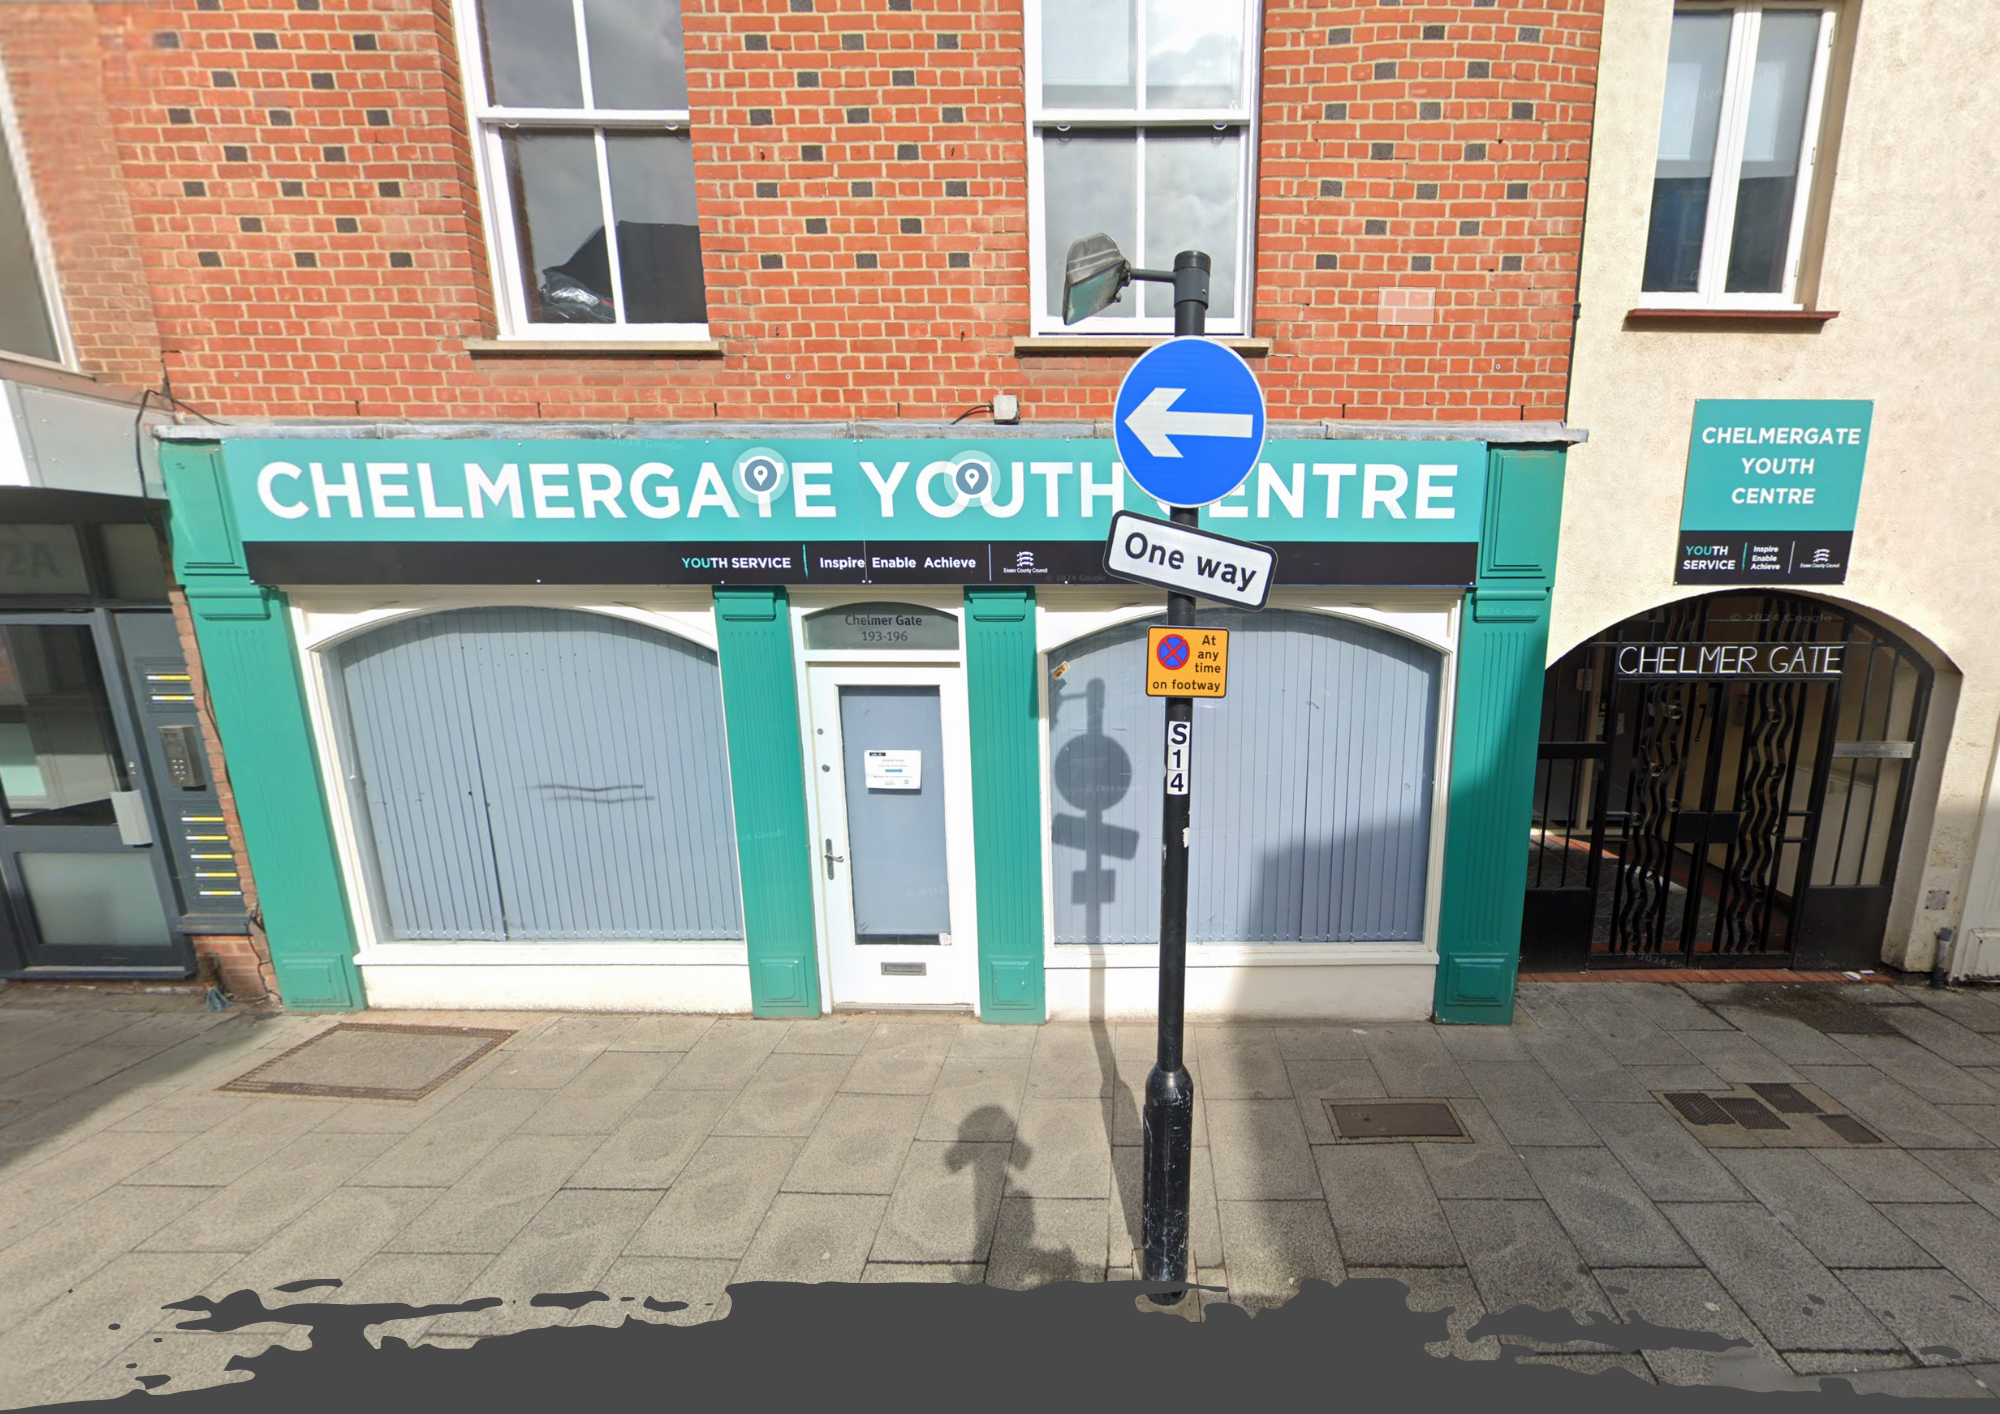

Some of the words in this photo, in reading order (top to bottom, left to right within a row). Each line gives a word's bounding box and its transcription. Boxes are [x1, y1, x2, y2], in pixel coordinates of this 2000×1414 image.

[1701, 426, 1862, 445] CHELMERGATE
[1741, 457, 1815, 475] YOUTH
[859, 460, 1124, 519] YOUTH
[1157, 461, 1458, 520] NTRE
[1731, 487, 1816, 505] CENTRE
[1686, 545, 1729, 556] YOUTH
[1753, 545, 1779, 554] Inspire
[682, 557, 728, 569] YOUTH
[732, 557, 792, 569] SERVICE
[819, 557, 866, 570] Inspire
[872, 557, 917, 568] Enable
[924, 557, 977, 568] Achieve
[1124, 531, 1185, 571] One
[1196, 554, 1257, 593] way
[1751, 554, 1778, 562] Enable
[1683, 559, 1736, 570] SERVICE
[845, 614, 893, 626] Chelmer
[895, 614, 923, 626] Gate
[861, 630, 908, 642] 193-196
[1202, 634, 1216, 646] At
[1197, 651, 1220, 662] any
[1618, 645, 1758, 674] CHELMER
[1768, 645, 1845, 674] GATE
[1194, 662, 1222, 674] time
[1152, 681, 1168, 690] on
[1171, 679, 1222, 692] footway
